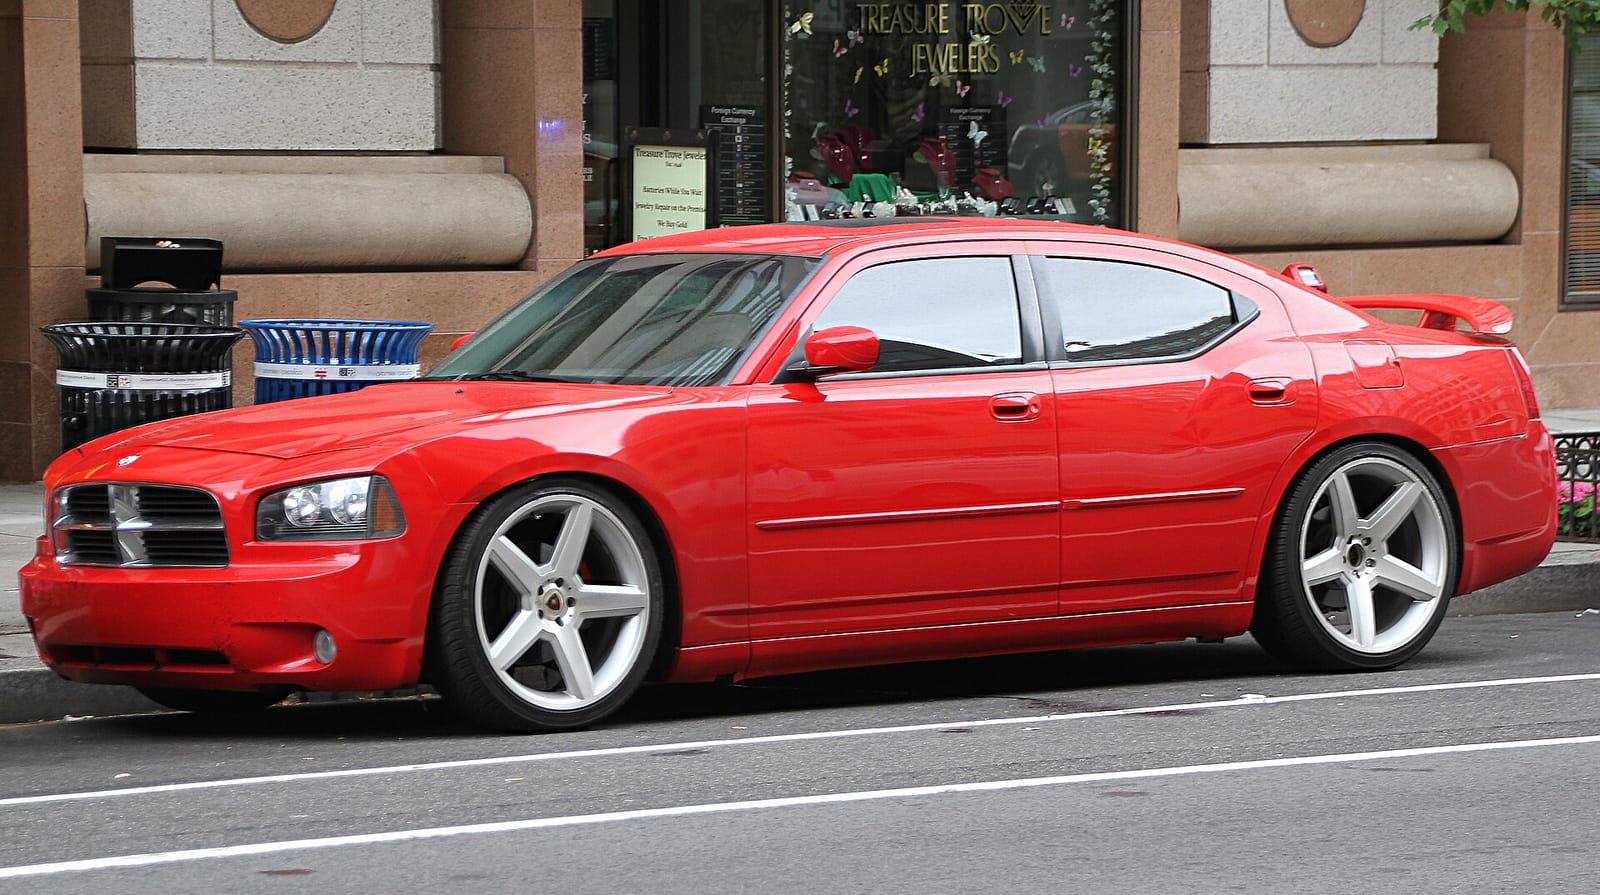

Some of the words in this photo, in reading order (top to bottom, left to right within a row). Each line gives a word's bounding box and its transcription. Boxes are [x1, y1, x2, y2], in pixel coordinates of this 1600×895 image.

[856, 3, 950, 34] TREASURE
[962, 2, 1052, 35] TROVE
[909, 43, 1000, 78] JEWELERS
[635, 148, 663, 158] Treasure
[664, 149, 682, 159] Trove
